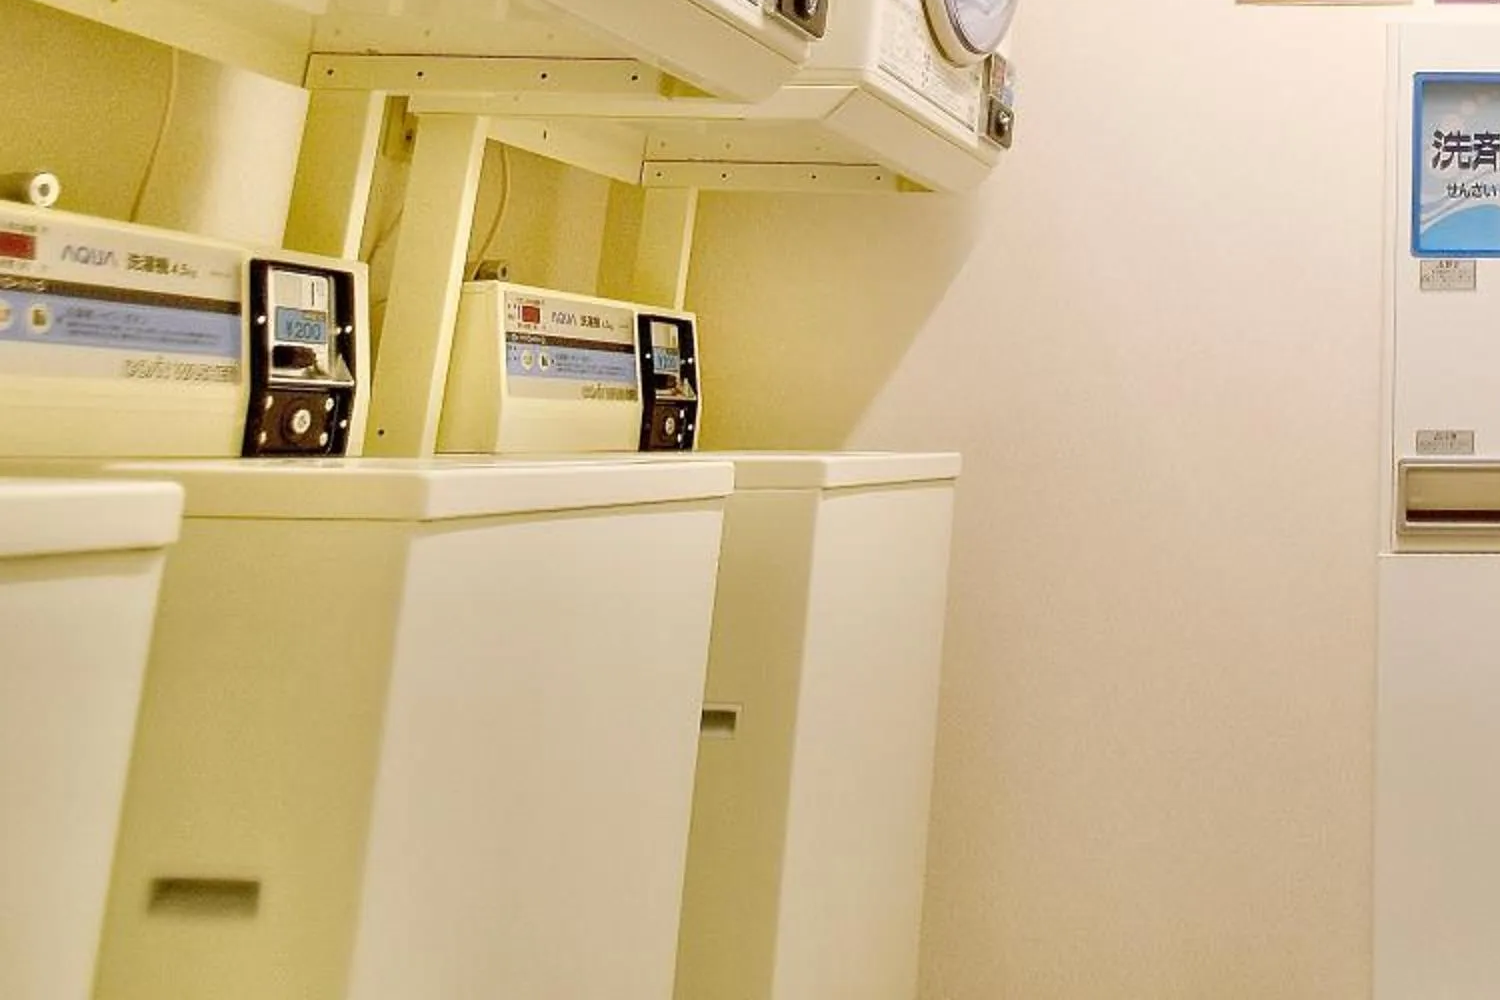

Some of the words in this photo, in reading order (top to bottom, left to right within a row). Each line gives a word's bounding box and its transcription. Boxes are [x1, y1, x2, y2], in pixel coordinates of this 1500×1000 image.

[1446, 182, 1498, 199] せんさい
[60, 245, 118, 266] AQUA
